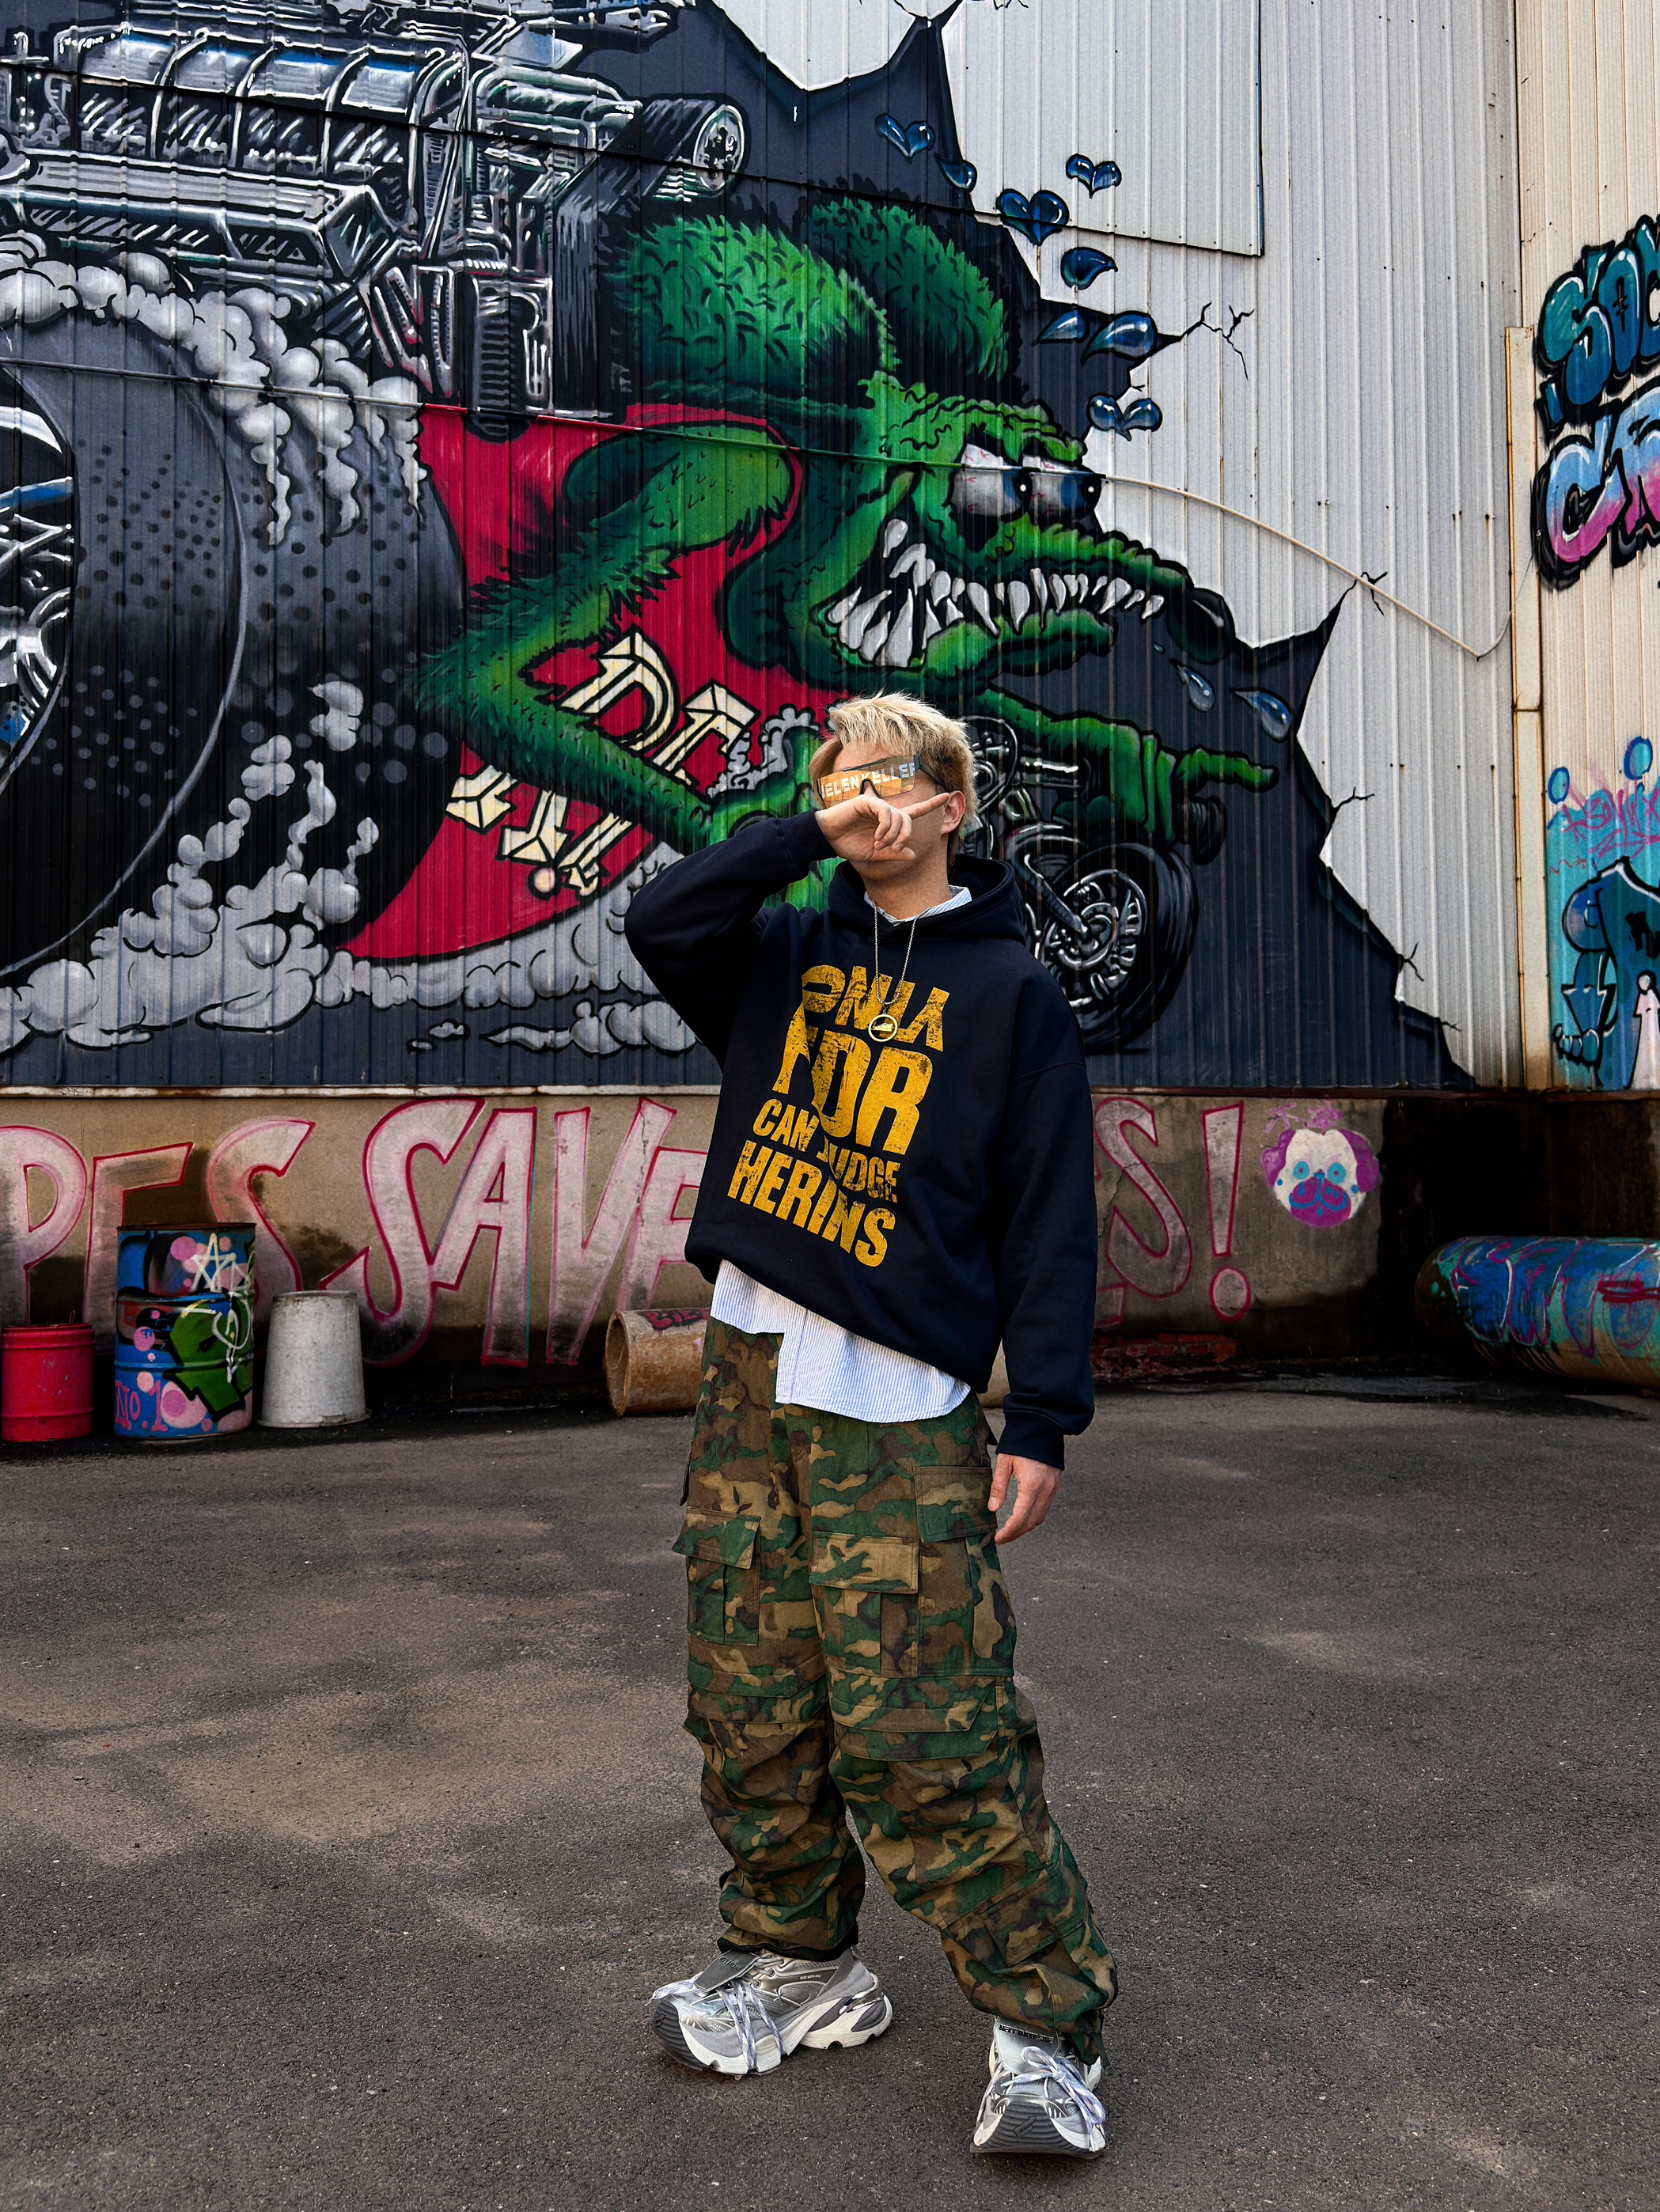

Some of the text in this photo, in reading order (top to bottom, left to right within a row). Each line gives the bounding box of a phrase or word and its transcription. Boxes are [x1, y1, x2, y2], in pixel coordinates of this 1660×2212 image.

[821, 762, 916, 799] ELENKELLER
[752, 1099, 900, 1203] CAN JUDGE
